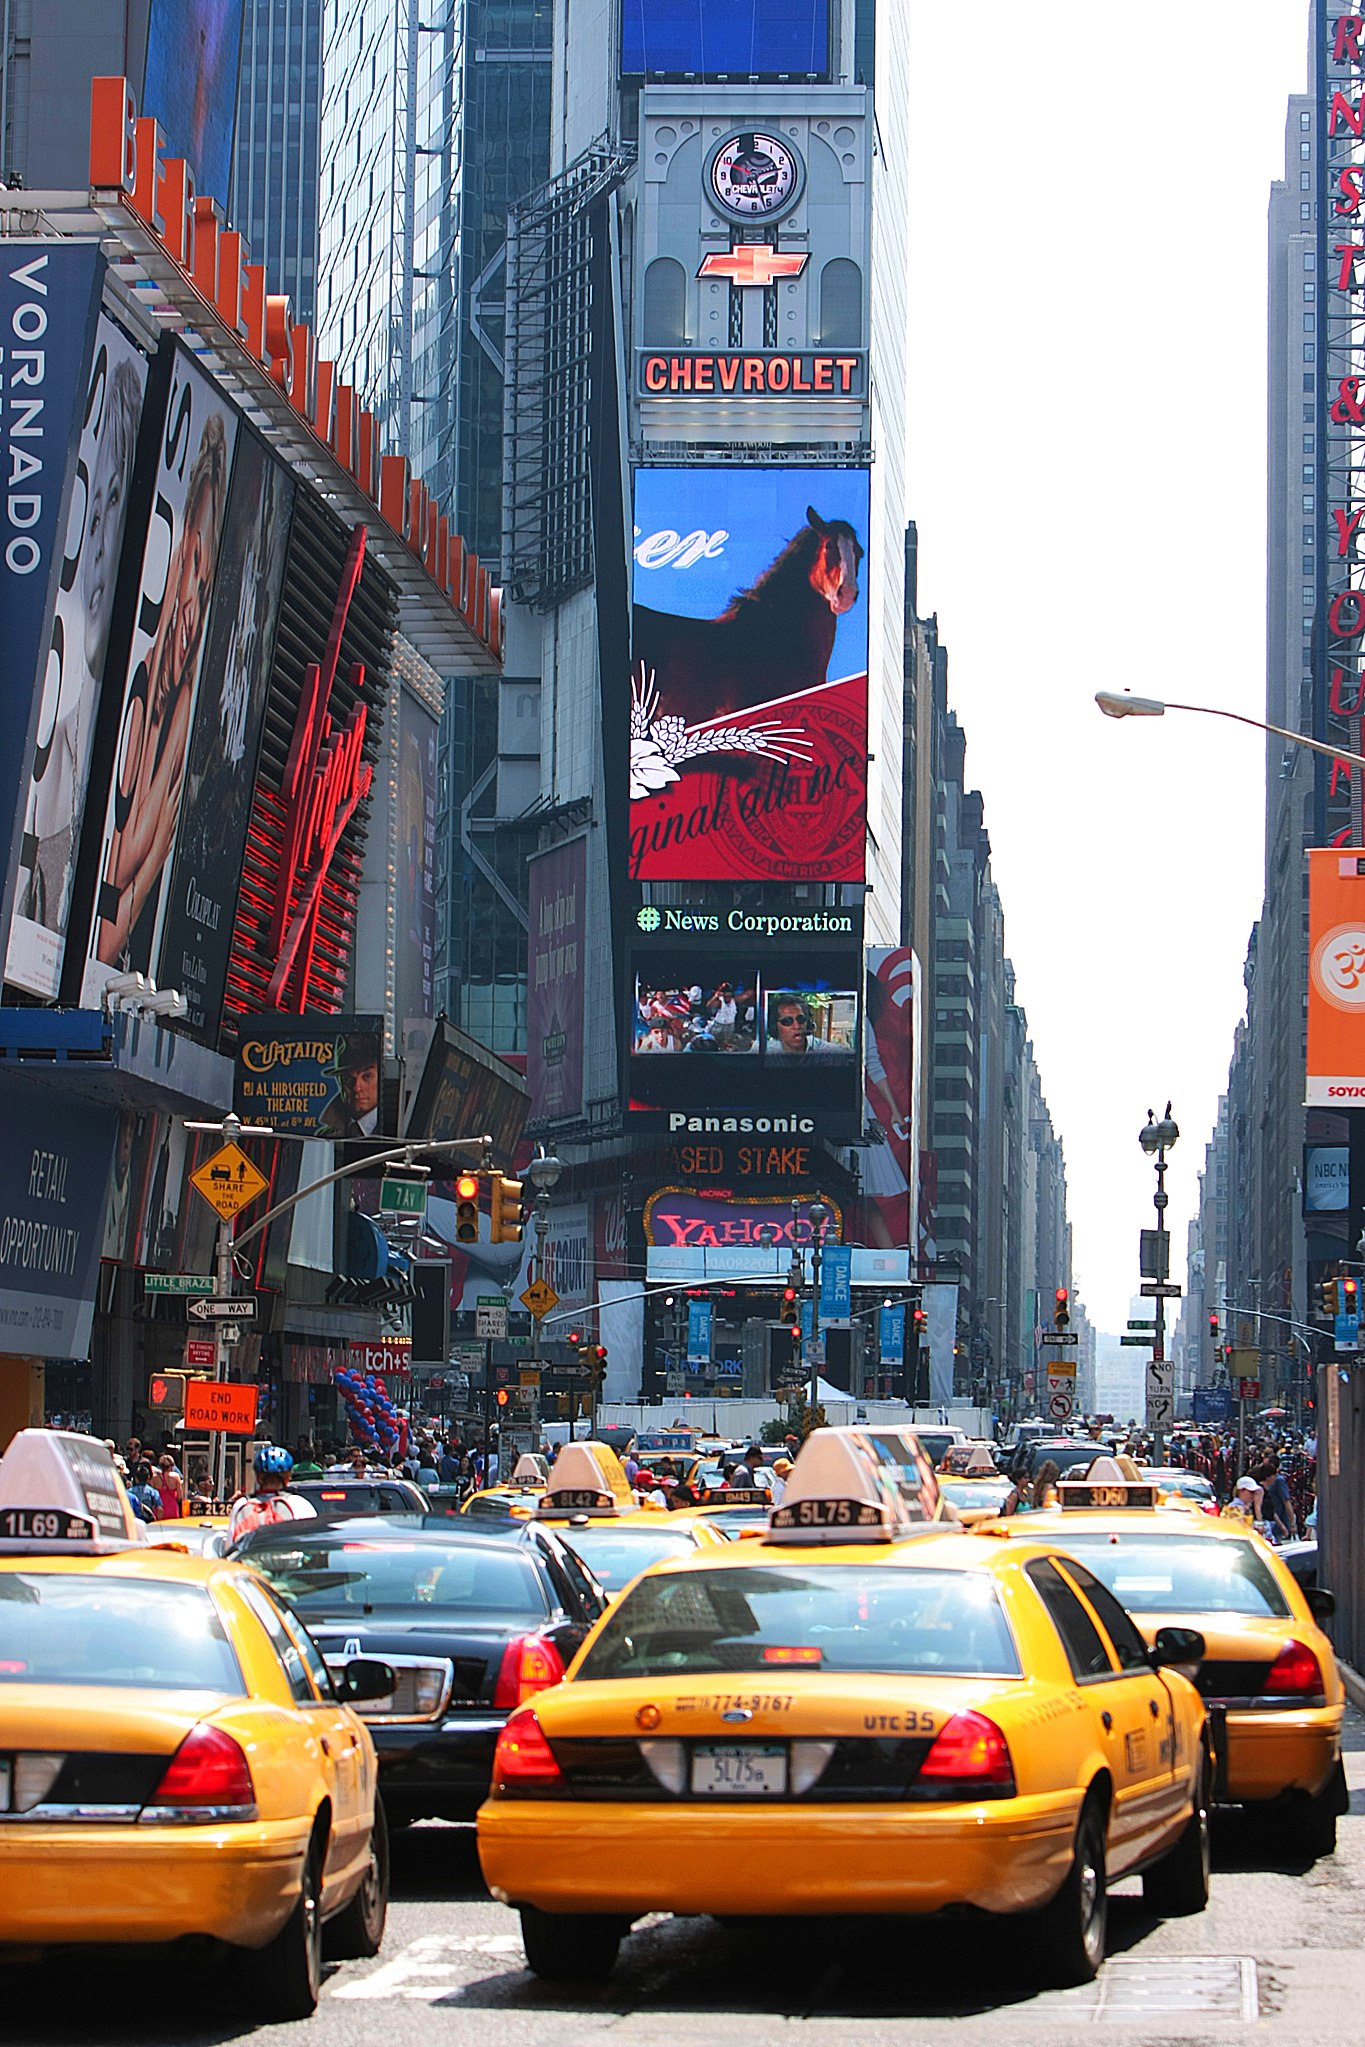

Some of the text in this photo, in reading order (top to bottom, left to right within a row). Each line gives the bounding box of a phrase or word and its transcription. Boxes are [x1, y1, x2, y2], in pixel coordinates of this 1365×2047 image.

[732, 184, 776, 194] CHEVRLET
[645, 357, 857, 390] CHEVROLET
[5, 254, 49, 575] VORNADO
[664, 910, 852, 936] News Corporation
[241, 1041, 334, 1073] CURTAINS
[256, 1081, 327, 1097] AL HIRSCHFELD
[266, 1098, 309, 1113] THEATRE
[669, 1112, 815, 1133] Panasonic
[738, 1146, 811, 1175] STAKE
[28, 1149, 68, 1203] RETAIL
[1315, 1163, 1349, 1178] NBC N
[213, 1182, 244, 1193] SHARE
[396, 1187, 402, 1206] 7
[216, 1201, 239, 1210] ROAD
[0, 1215, 80, 1276] OPPORTUNITY
[544, 1236, 587, 1295] RECOUNT
[145, 1276, 212, 1289] LITTLE BRAZIL
[835, 1265, 847, 1301] DANCE
[197, 1304, 249, 1314] ONE WAY
[477, 1319, 505, 1328] SHARED
[481, 1328, 501, 1336] LANE
[891, 1318, 901, 1345] DANCE
[365, 1347, 411, 1373] tch+s
[1158, 1363, 1172, 1372] NO
[211, 1392, 232, 1404] END
[1149, 1386, 1171, 1394] TURN
[190, 1409, 250, 1423] ROAD WORK
[206, 1504, 233, 1516] 2L26
[800, 1501, 851, 1524] 5L75
[5, 1512, 60, 1538] 1L69
